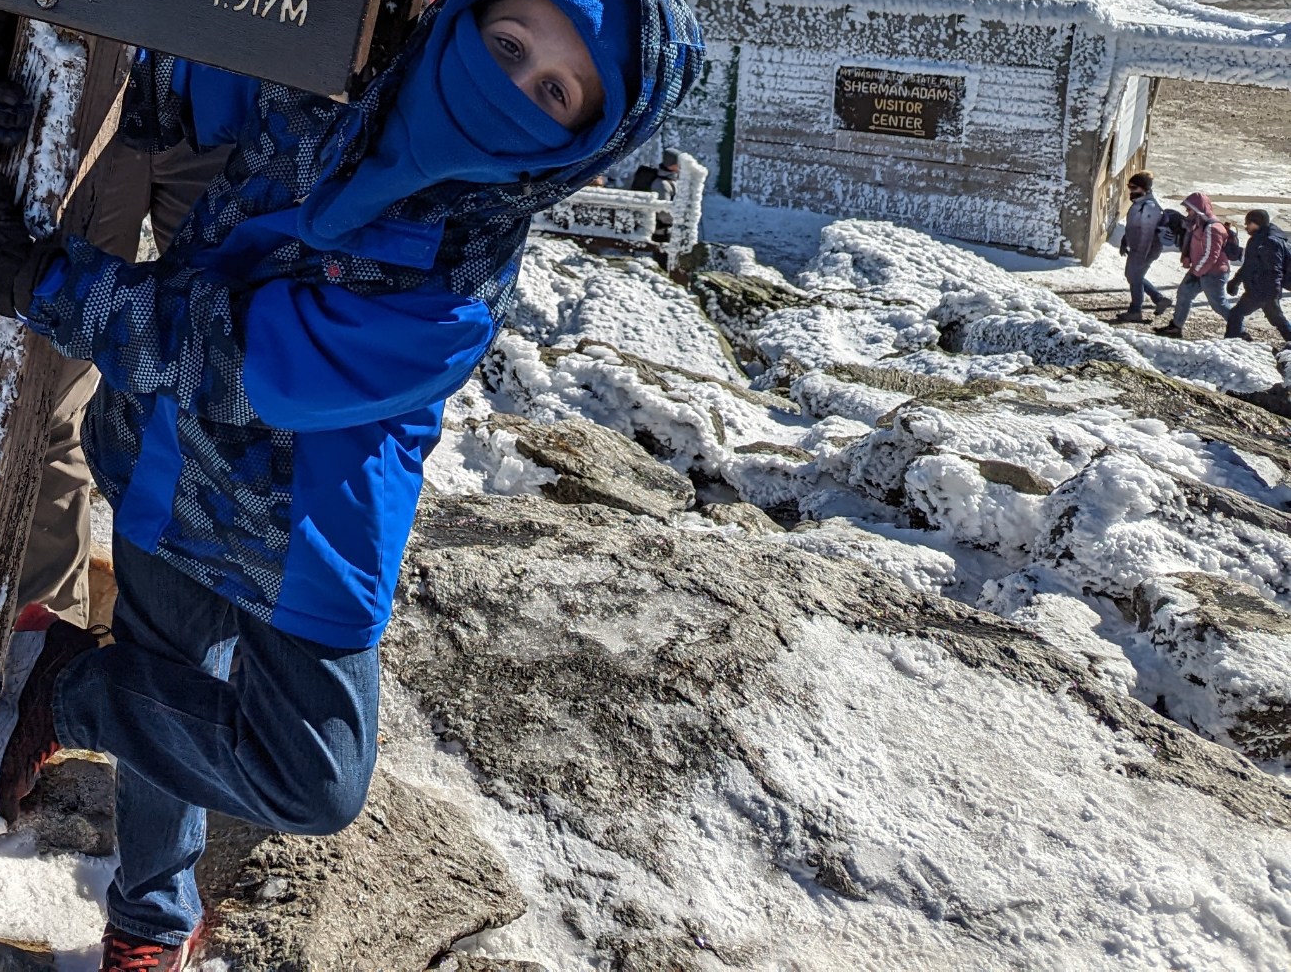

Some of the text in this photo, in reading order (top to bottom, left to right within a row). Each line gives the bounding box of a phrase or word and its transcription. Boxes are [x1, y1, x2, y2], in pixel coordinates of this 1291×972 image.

[843, 80, 957, 102] SHERMAN ADAMS
[874, 98, 923, 114] VISITOR
[872, 113, 923, 130] CENTER
